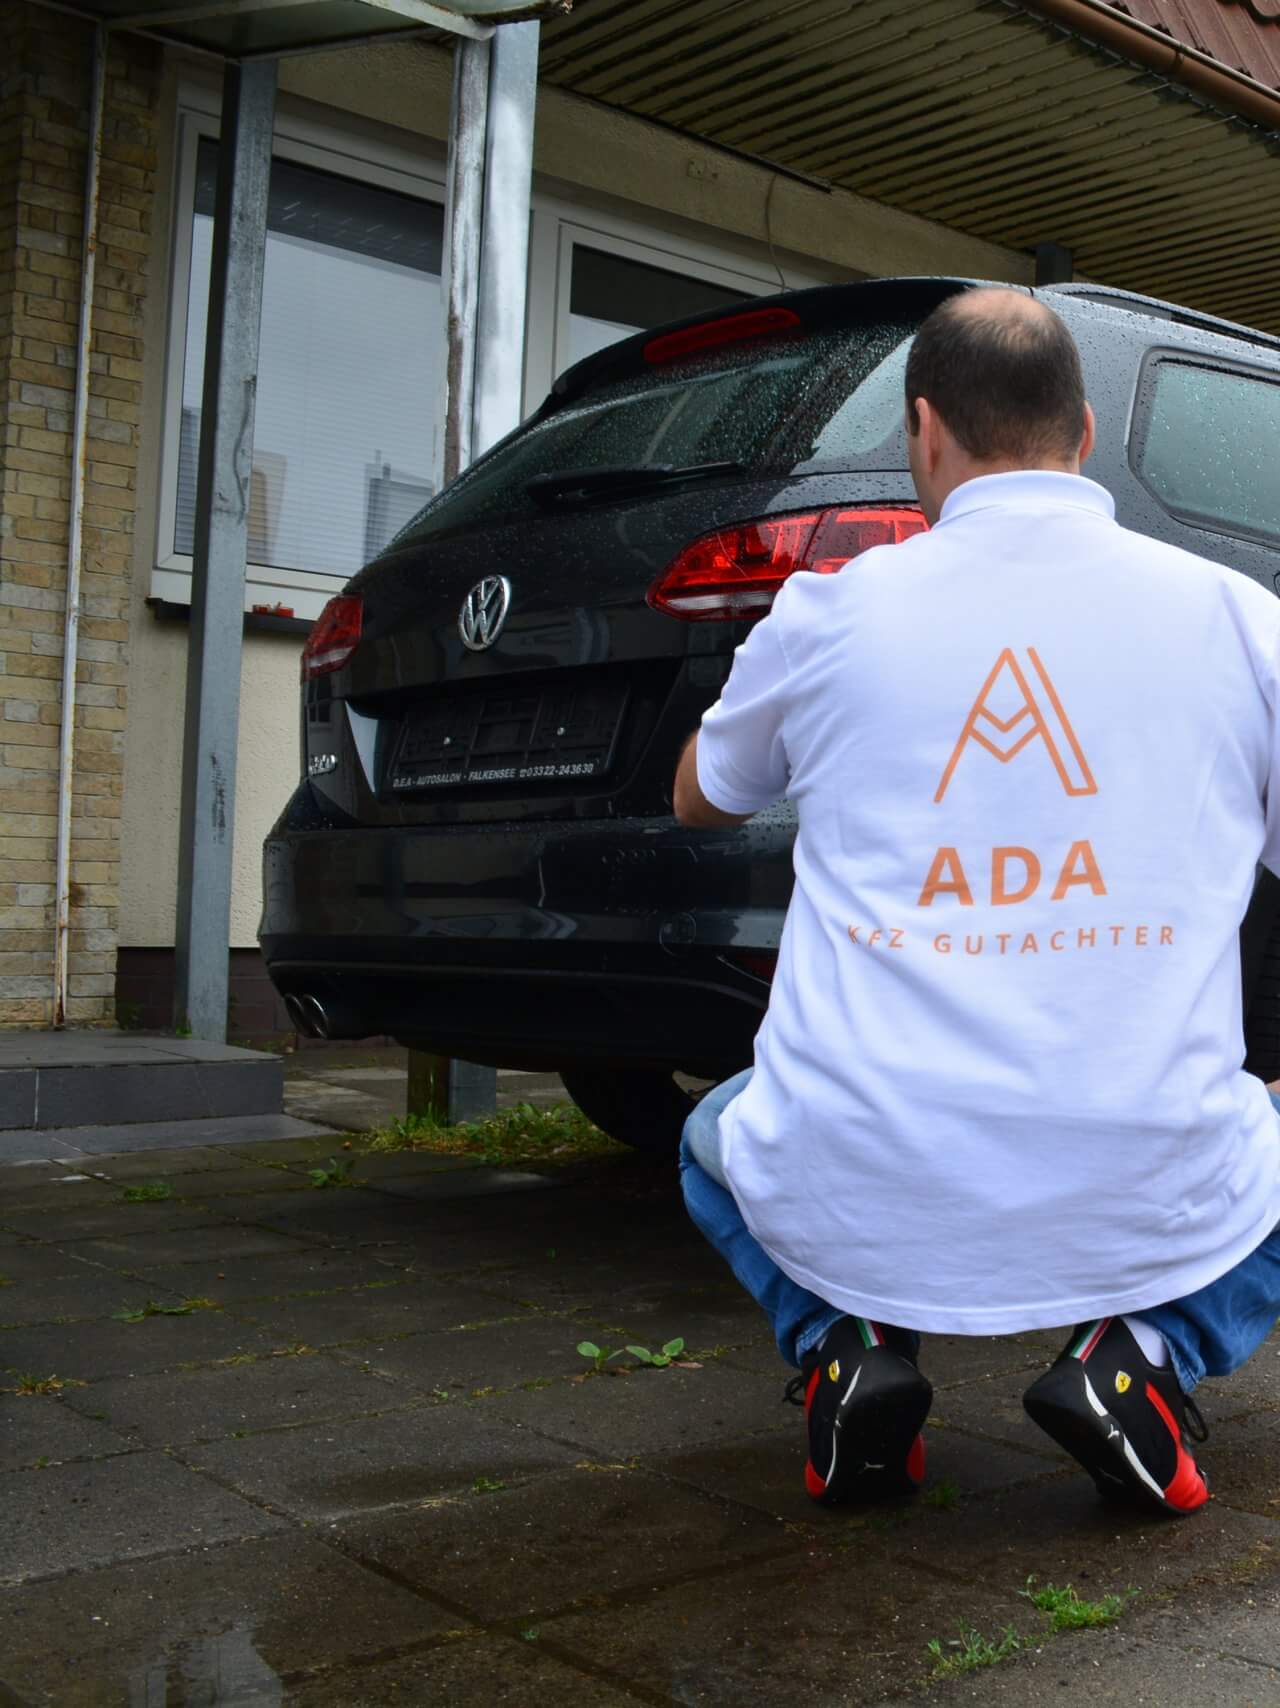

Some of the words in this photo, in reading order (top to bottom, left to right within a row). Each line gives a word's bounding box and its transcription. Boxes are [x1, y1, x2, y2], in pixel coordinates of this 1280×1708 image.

[416, 772, 462, 786] AUTOSALON
[468, 767, 516, 781] FALKENSEE
[917, 839, 1108, 906] ADA
[847, 923, 905, 947] KFZ
[932, 925, 1175, 956] GUTACHTER
